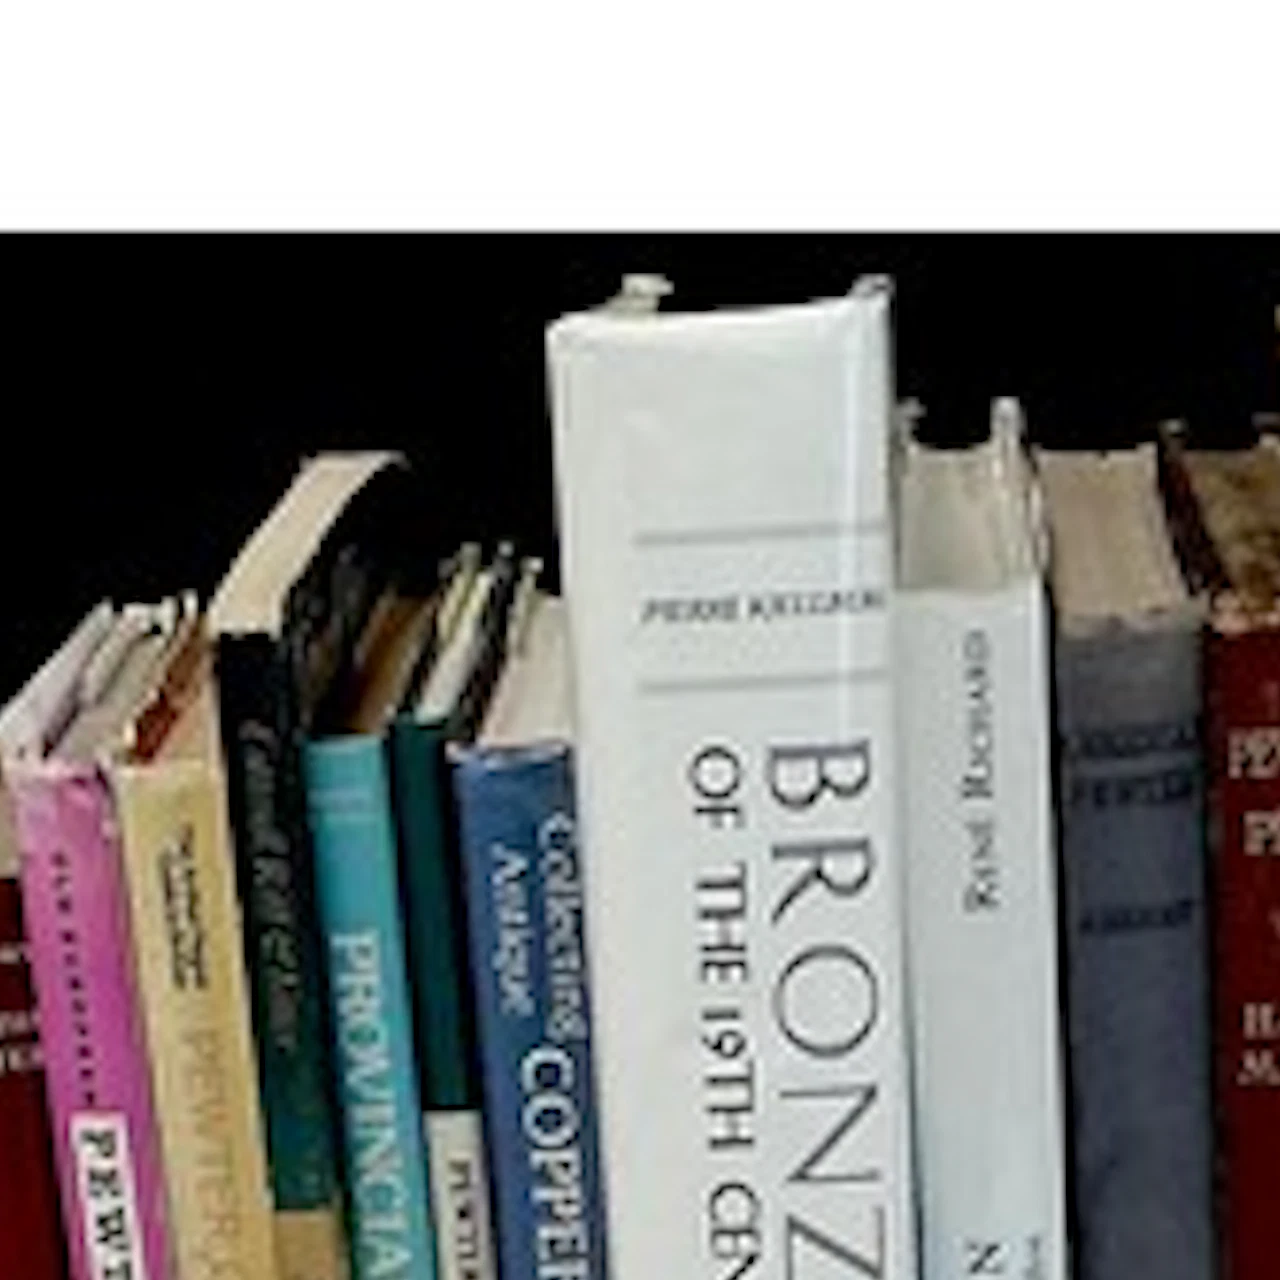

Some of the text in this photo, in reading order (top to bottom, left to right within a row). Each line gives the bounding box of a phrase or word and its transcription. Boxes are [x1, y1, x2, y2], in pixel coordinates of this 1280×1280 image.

[640, 597, 742, 627] PIERRE
[689, 744, 747, 829] OF
[491, 843, 536, 1018] Antique
[693, 862, 750, 983] THE
[698, 1008, 757, 1152] 19TH
